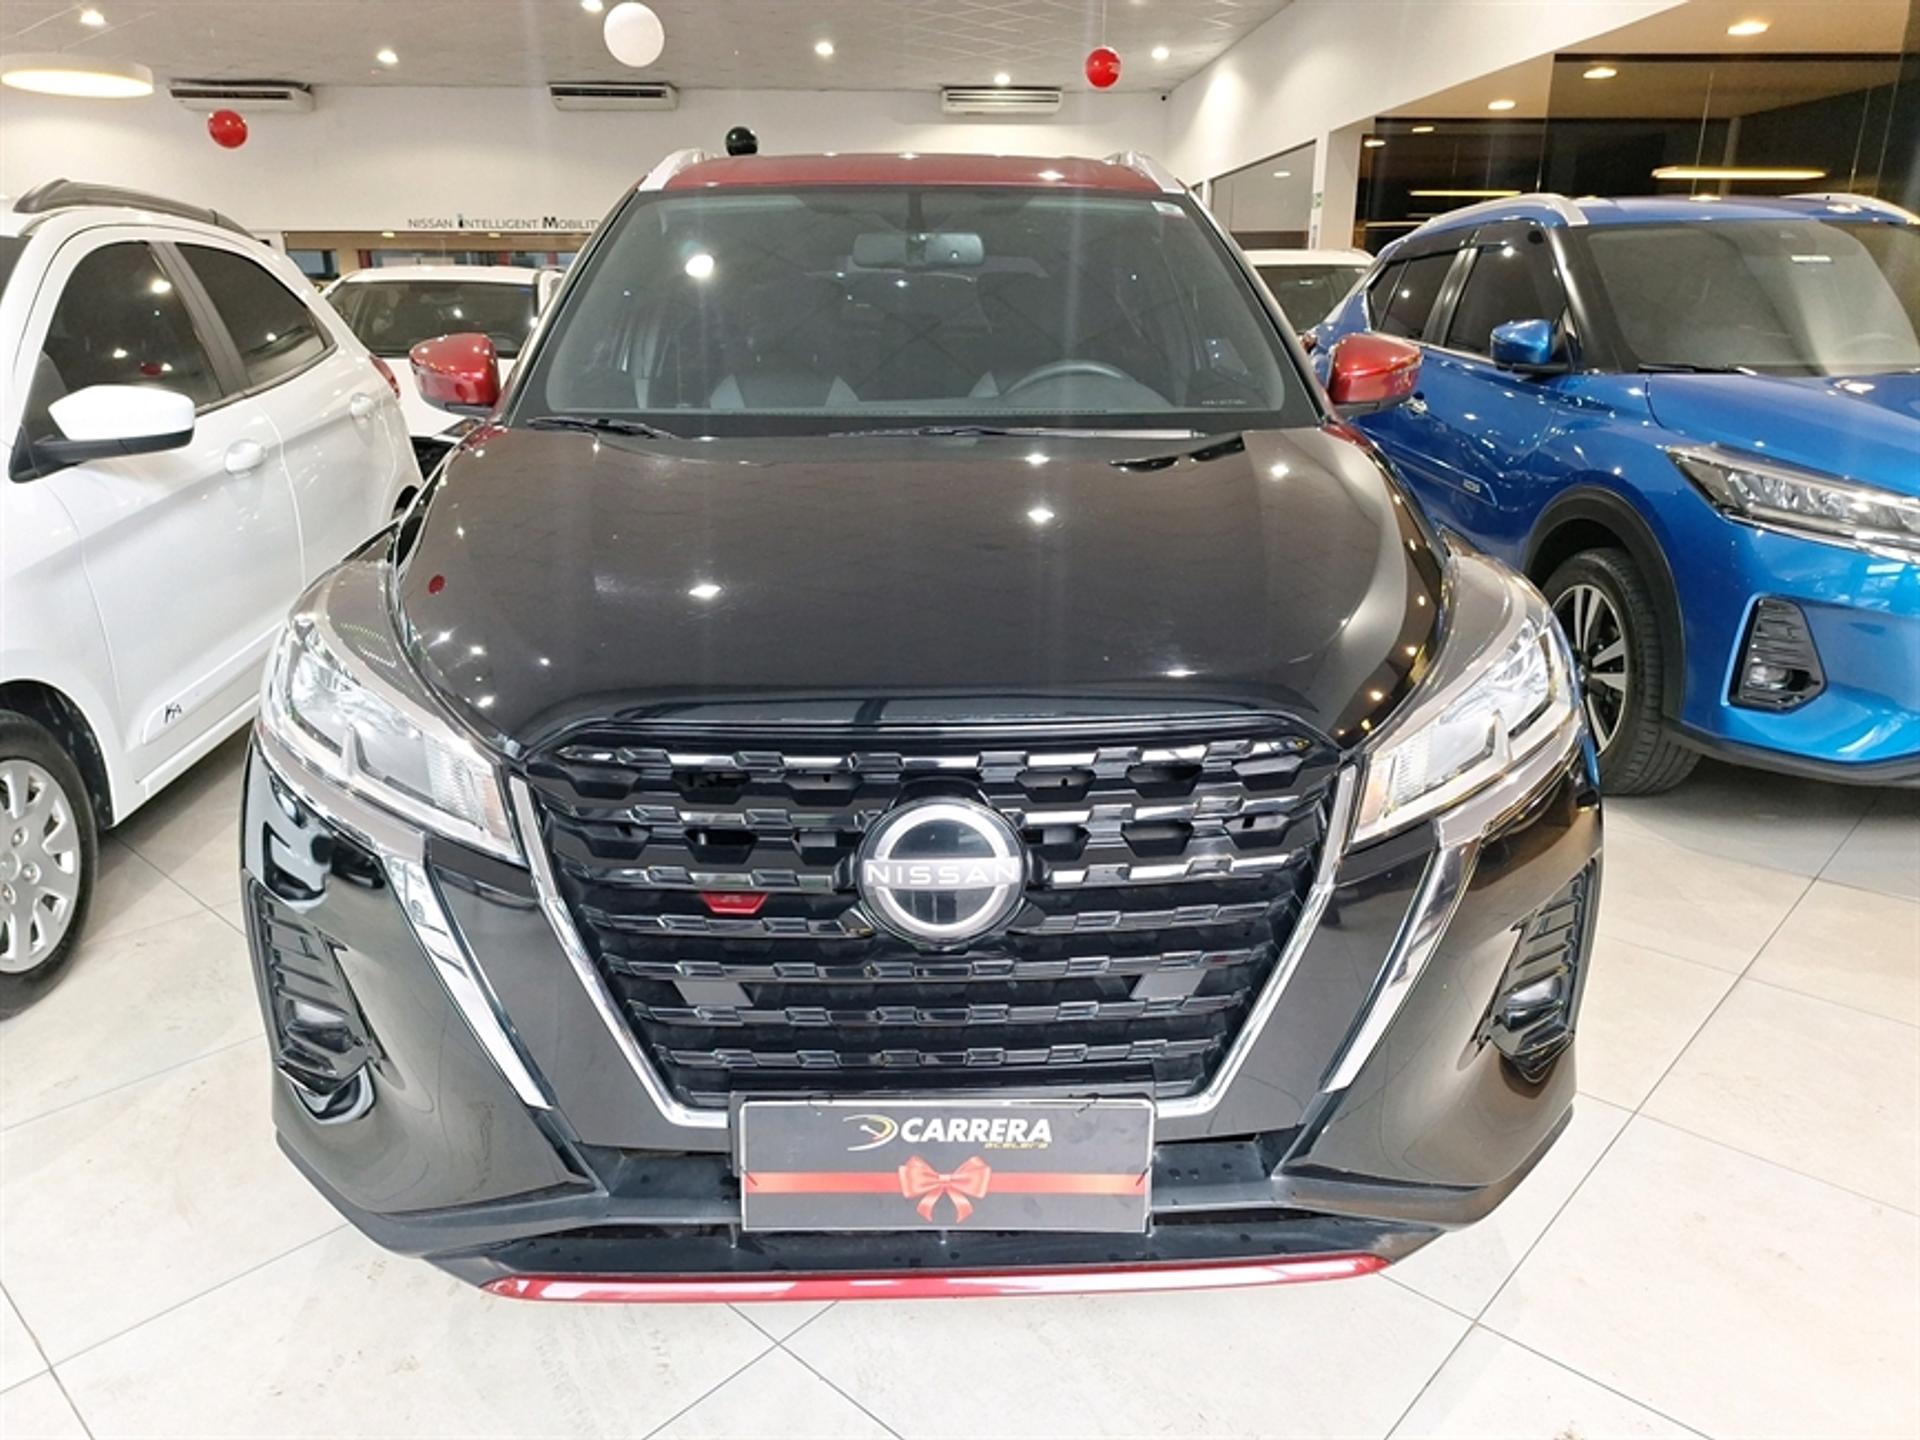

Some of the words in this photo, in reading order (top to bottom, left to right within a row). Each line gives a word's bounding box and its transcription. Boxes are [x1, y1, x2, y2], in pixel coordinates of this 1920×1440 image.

[408, 218, 453, 229] NISSAN
[457, 212, 538, 229] INTELLIGENT
[866, 862, 1017, 885] NISSAN
[900, 1117, 1053, 1142] CARRERA
